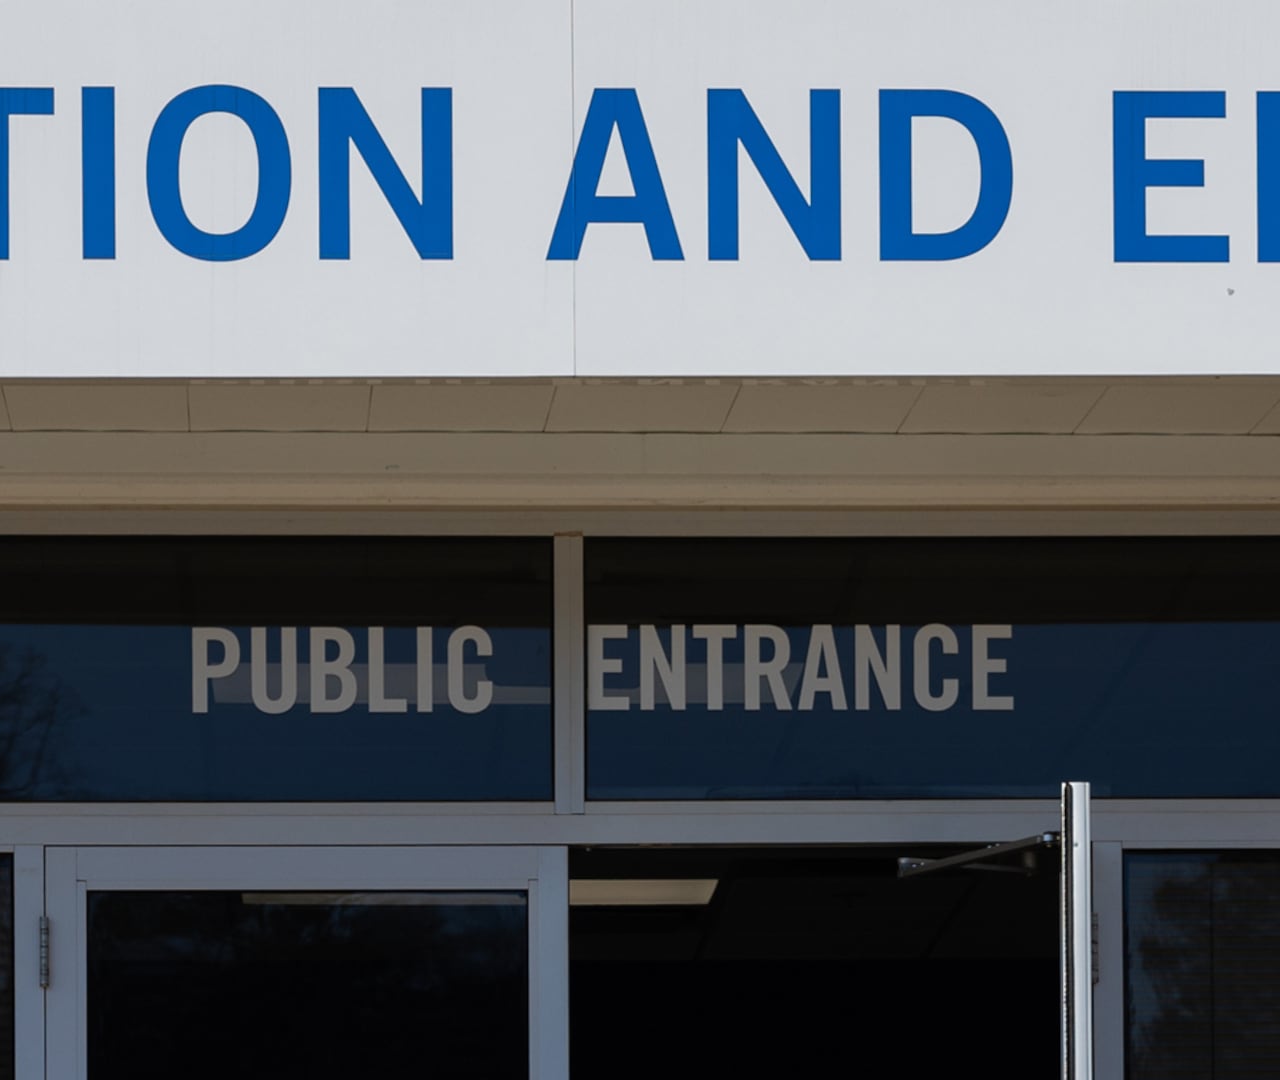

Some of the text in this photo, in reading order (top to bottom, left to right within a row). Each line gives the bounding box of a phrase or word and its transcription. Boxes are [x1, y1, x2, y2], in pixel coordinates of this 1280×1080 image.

[546, 87, 1014, 263] AND
[191, 623, 1014, 714] PUBLIC ENTRANCE
